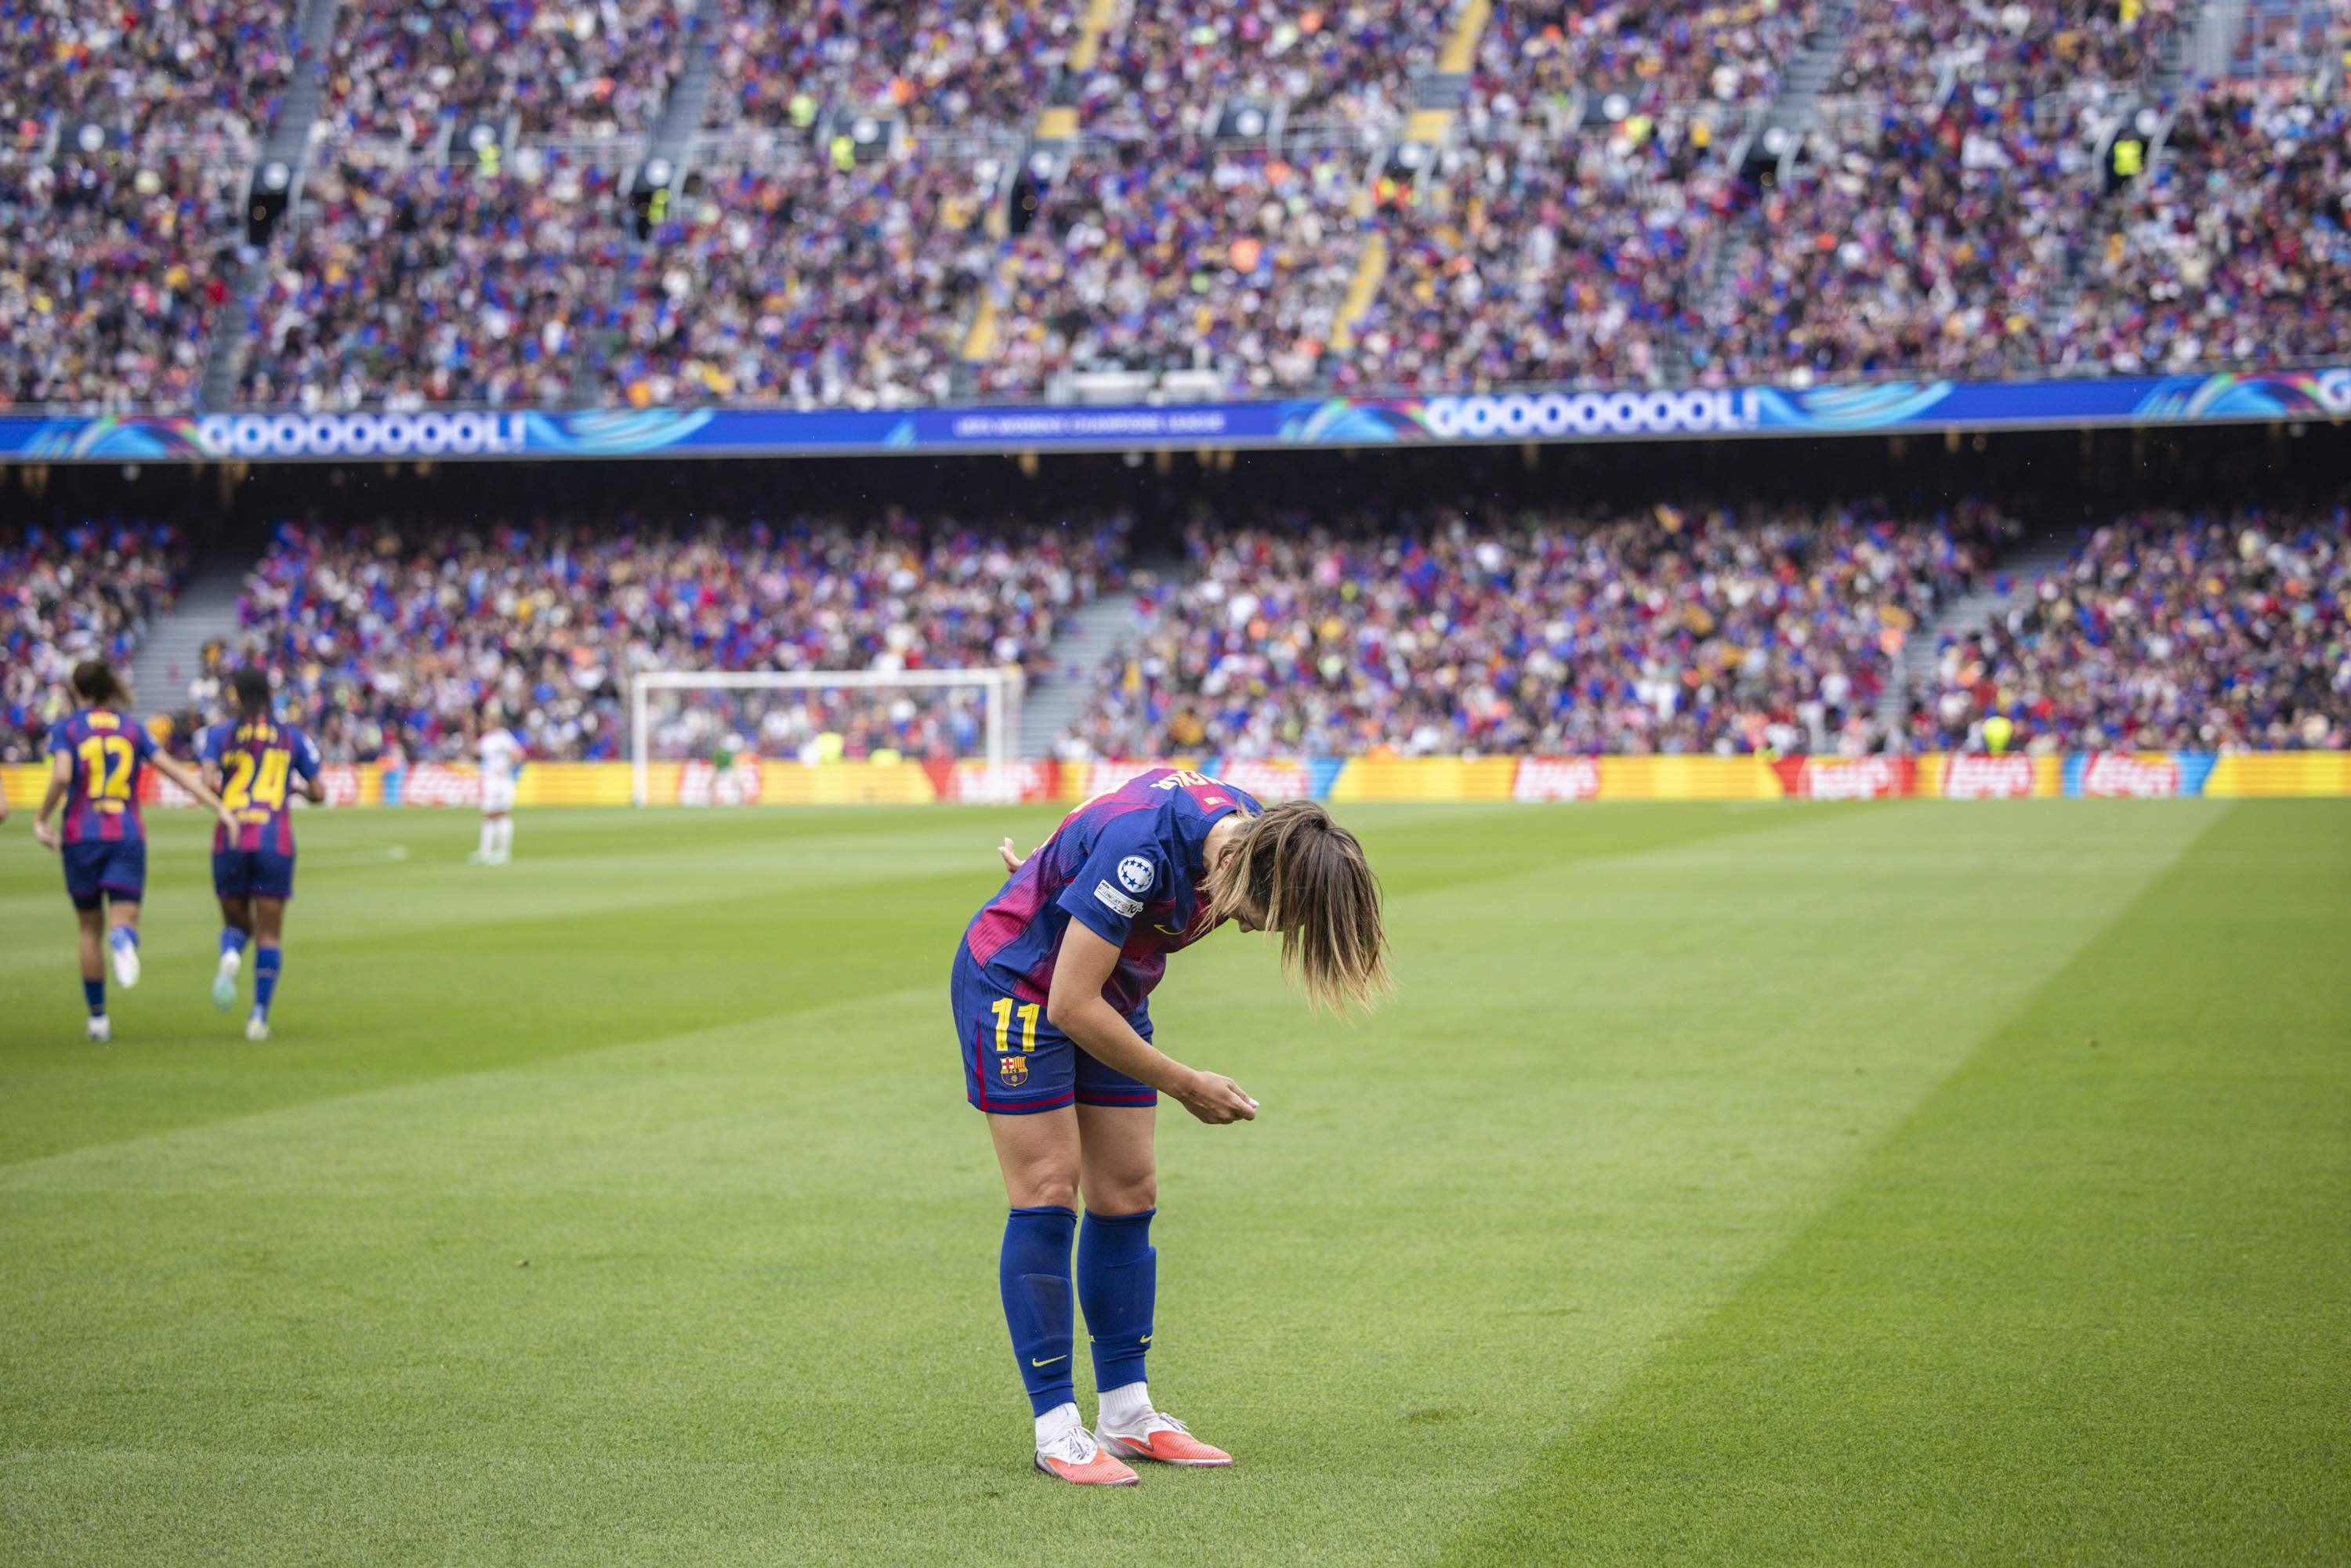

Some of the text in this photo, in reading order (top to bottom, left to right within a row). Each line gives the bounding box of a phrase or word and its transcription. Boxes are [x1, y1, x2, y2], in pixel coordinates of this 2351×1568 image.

[78, 736, 133, 799] 12
[222, 748, 291, 810] 24
[991, 998, 1040, 1052] 11
